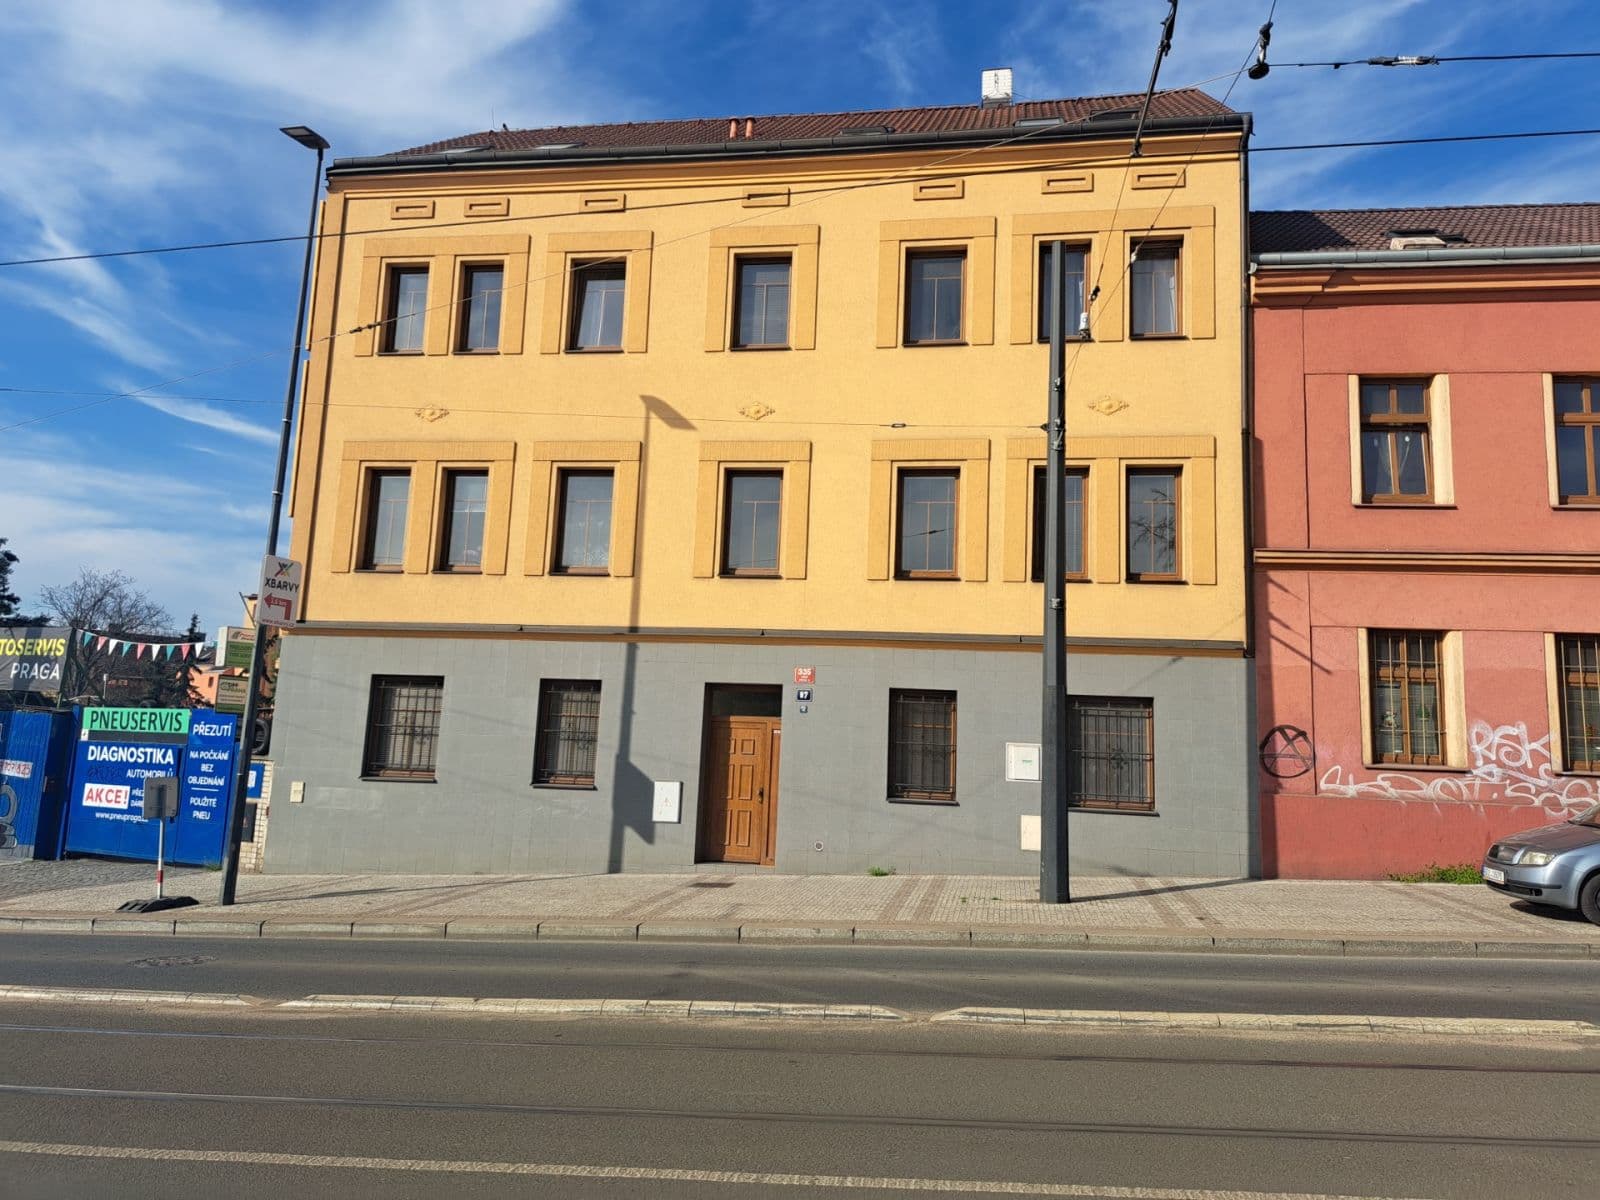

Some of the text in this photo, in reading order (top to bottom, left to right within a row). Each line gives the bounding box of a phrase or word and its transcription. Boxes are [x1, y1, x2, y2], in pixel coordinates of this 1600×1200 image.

[264, 577, 300, 592] XBARVY
[0, 638, 66, 656] TOSERVIS
[10, 662, 60, 680] PRAGA
[90, 710, 183, 732] PNEUSERVIS
[192, 721, 233, 737] PŘEZUTÍ
[88, 745, 174, 765] DIAGNOSTIKA
[189, 749, 230, 760] NA POČKÁNÍ
[200, 763, 214, 773] BEZ
[187, 775, 226, 786] OBJEDNÁNÍ
[85, 788, 129, 805] AKCE!
[192, 810, 211, 820] PNEU
